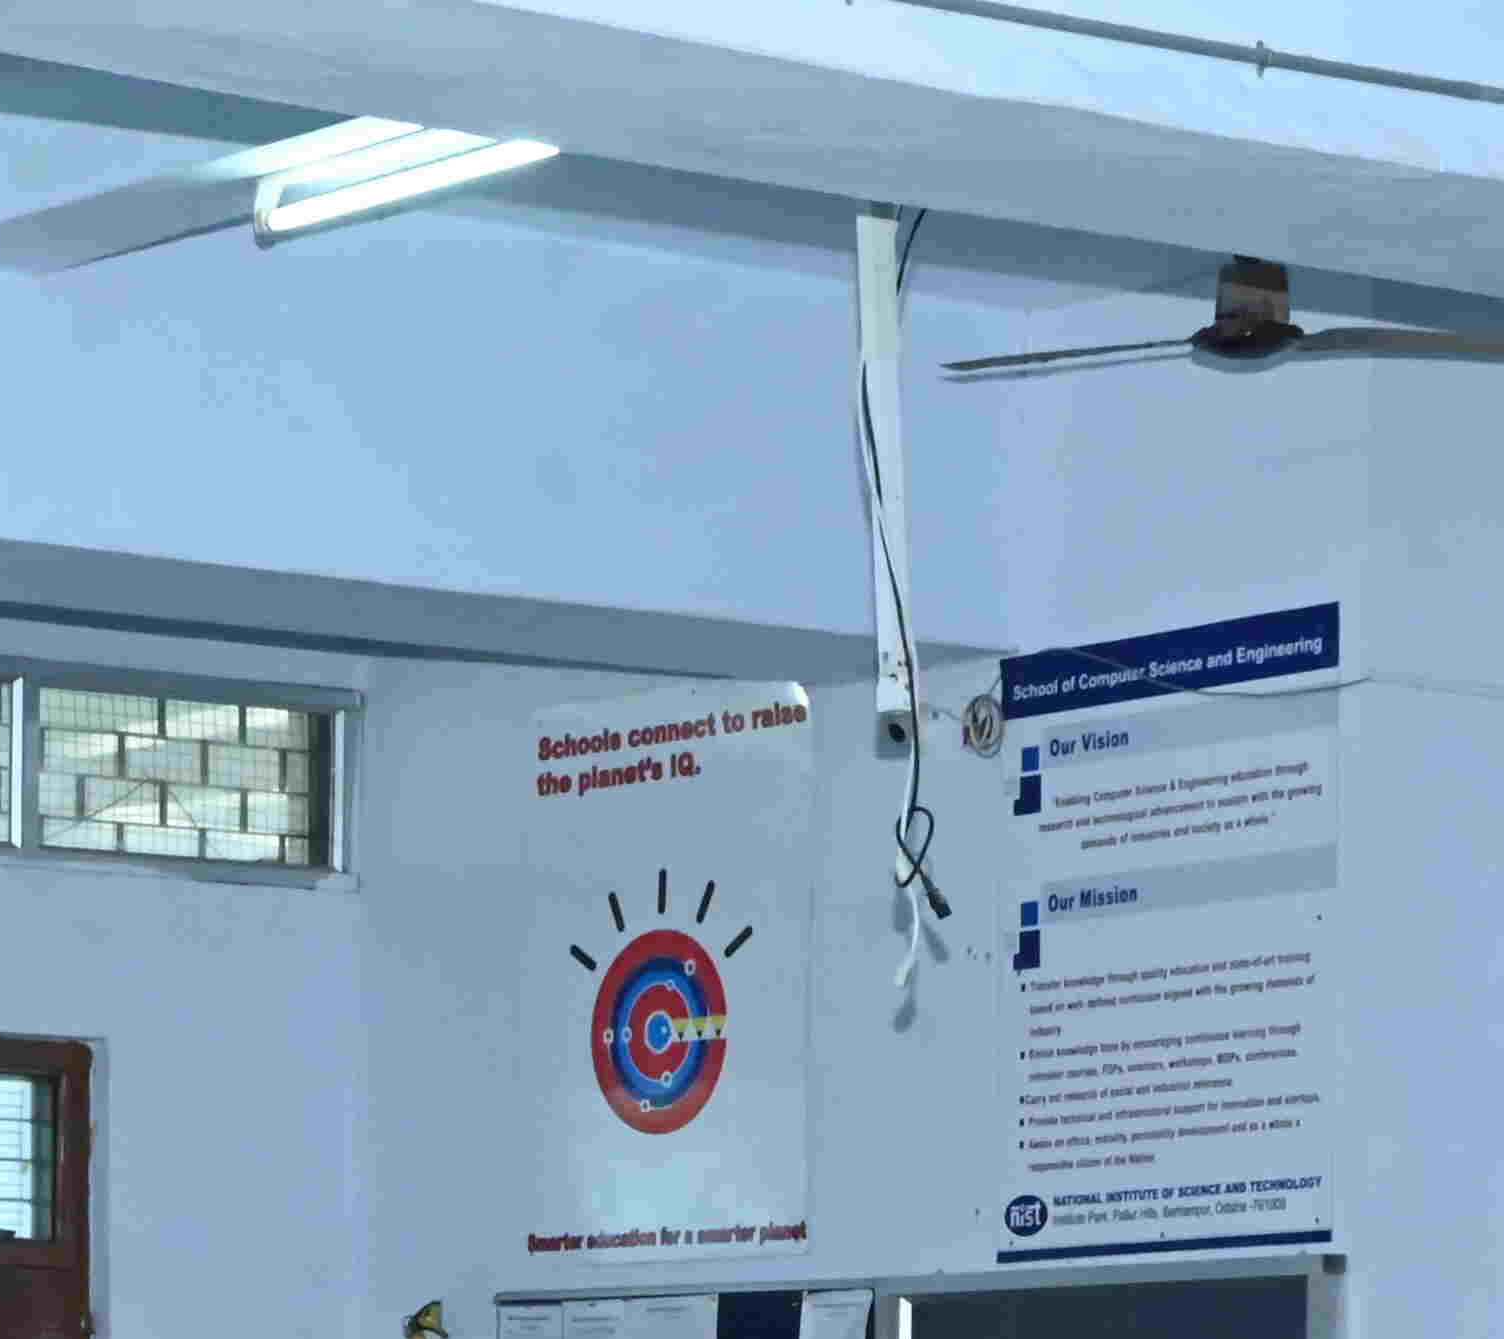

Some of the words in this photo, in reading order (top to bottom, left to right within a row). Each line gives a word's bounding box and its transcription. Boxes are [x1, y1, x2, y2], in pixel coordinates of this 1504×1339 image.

[1012, 679, 1059, 701] School
[1061, 674, 1076, 694] of
[1149, 657, 1203, 679] Science
[1207, 651, 1233, 670] and
[1236, 636, 1323, 664] Engineering
[537, 727, 622, 761] Schools
[627, 712, 716, 748] connect
[721, 709, 745, 735] to
[1049, 737, 1076, 758] Our
[1081, 728, 1130, 753] Vision
[536, 771, 572, 797] the
[578, 756, 663, 797] planet's
[670, 751, 702, 778] IQ.
[1048, 892, 1075, 913] Our
[1079, 886, 1139, 909] Mission
[1053, 1192, 1104, 1208] NATIONAL
[1105, 1187, 1161, 1204] INSTITUTE
[1162, 1186, 1175, 1200] OF
[1178, 1182, 1222, 1198] SCIENCE
[1223, 1180, 1247, 1195] AND
[1249, 1175, 1323, 1193] TECHNOLOGY
[528, 1232, 584, 1254] Smarter
[586, 1227, 658, 1250] education
[660, 1225, 681, 1246] for
[759, 1219, 808, 1246] planet
